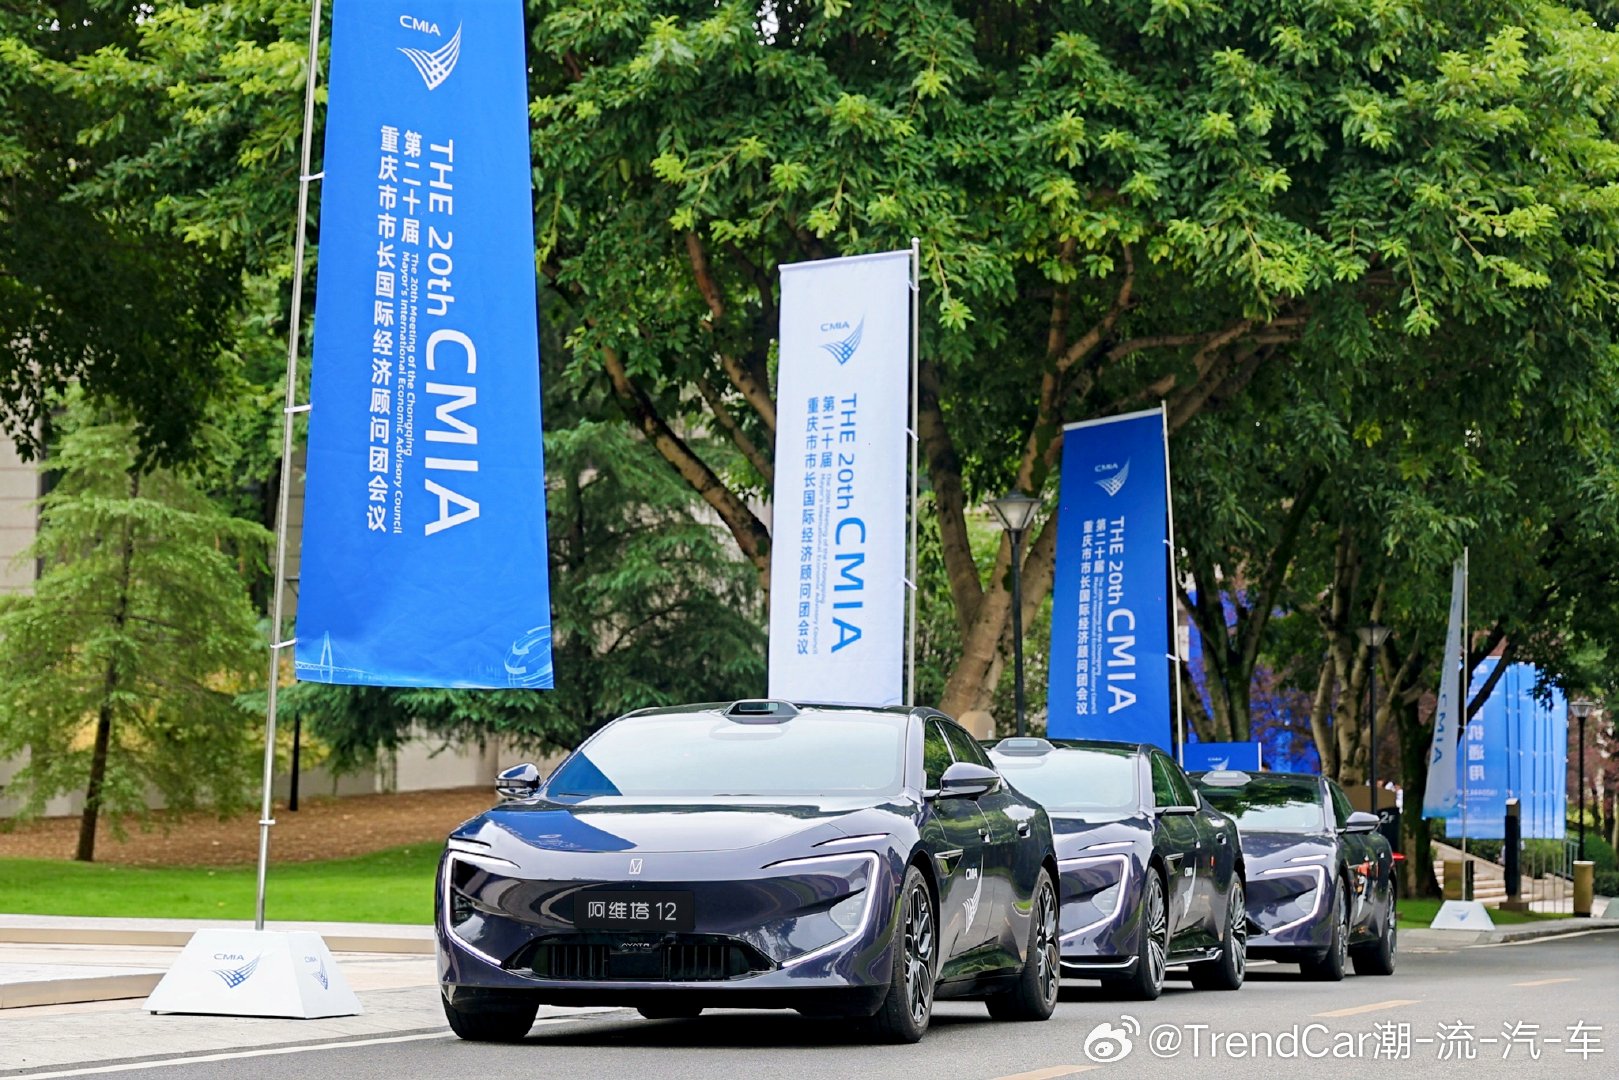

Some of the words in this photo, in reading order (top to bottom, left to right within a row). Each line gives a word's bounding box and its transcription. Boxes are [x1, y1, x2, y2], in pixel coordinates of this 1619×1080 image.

[399, 14, 441, 37] CMIA
[402, 130, 422, 245] 第二十届
[429, 139, 454, 215] THE
[400, 251, 409, 296] Mayor's
[410, 253, 419, 273] The
[427, 226, 455, 316] 20th
[410, 278, 419, 302] 20th
[367, 126, 400, 532] 重庆市市长国际经济顾问团会议
[399, 299, 408, 374] International
[407, 306, 418, 352] Meeting
[820, 321, 850, 332] CMIA
[407, 370, 415, 389] the
[408, 356, 416, 368] of
[396, 378, 405, 434] Economic
[404, 392, 415, 456] Chongqing
[840, 393, 856, 443] THE
[425, 329, 480, 536] CMIA
[821, 396, 835, 468] 第二十届
[394, 436, 404, 487] Advisory
[837, 453, 854, 509] 20th
[394, 490, 403, 534] Council
[798, 397, 818, 654] 重庆市市长国际经济顾问团会议
[1110, 516, 1124, 555] THE
[1094, 518, 1106, 573] 第二十届
[831, 517, 865, 653] CMIA
[1108, 560, 1124, 604] 20th
[1107, 608, 1136, 714] CMIA
[588, 901, 649, 919] 阿维塔
[655, 902, 677, 921] 12
[213, 953, 245, 961] CMIA
